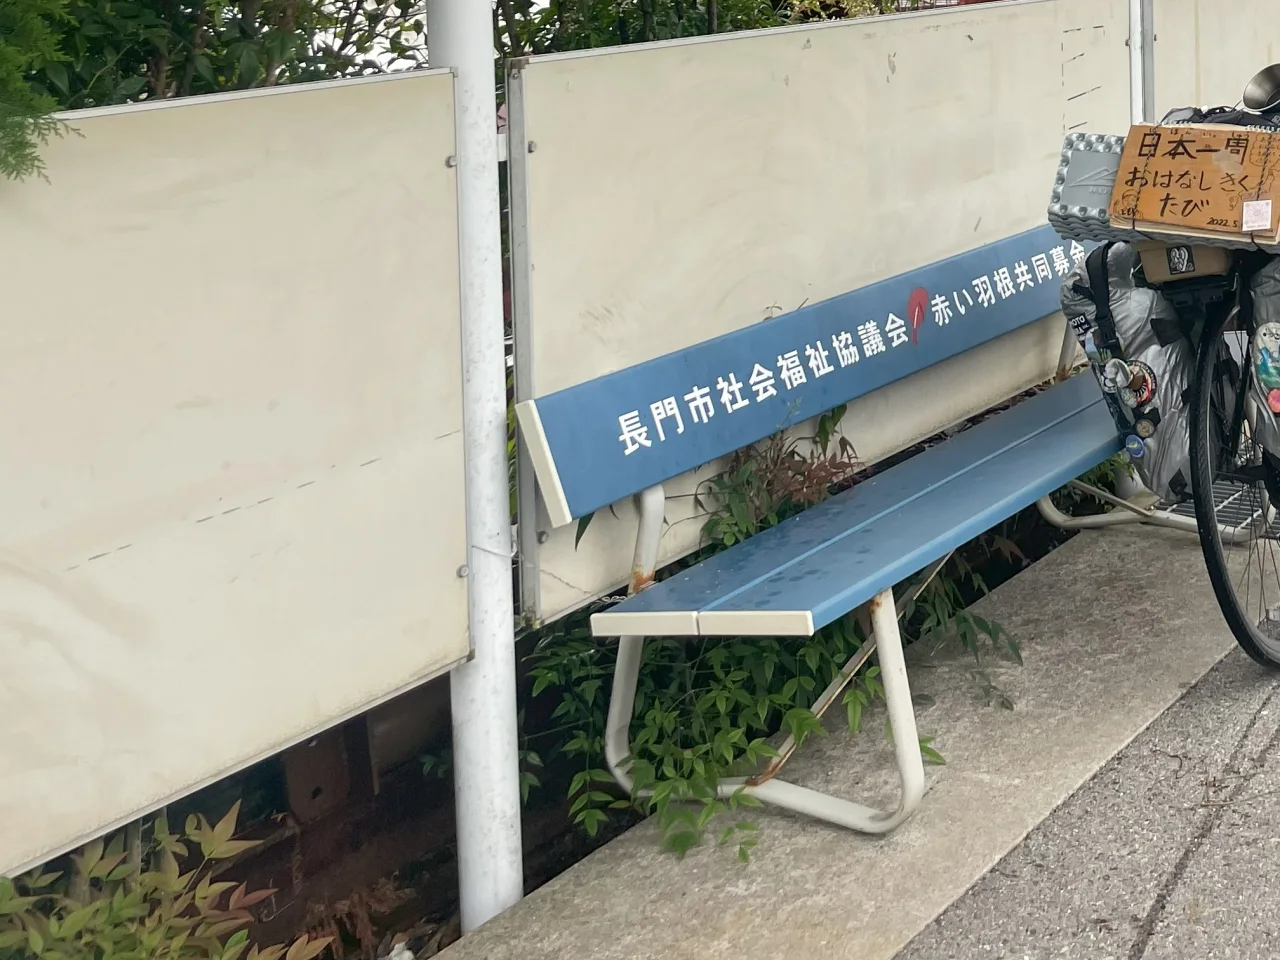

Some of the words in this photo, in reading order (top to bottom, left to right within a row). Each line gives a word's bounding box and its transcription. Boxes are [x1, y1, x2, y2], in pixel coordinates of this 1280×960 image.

[1138, 132, 1250, 166] 日本一周
[1160, 192, 1210, 218] たび
[616, 311, 910, 457] 長門市社会福祉協議会
[930, 239, 1086, 328] 赤い羽根共同募金
